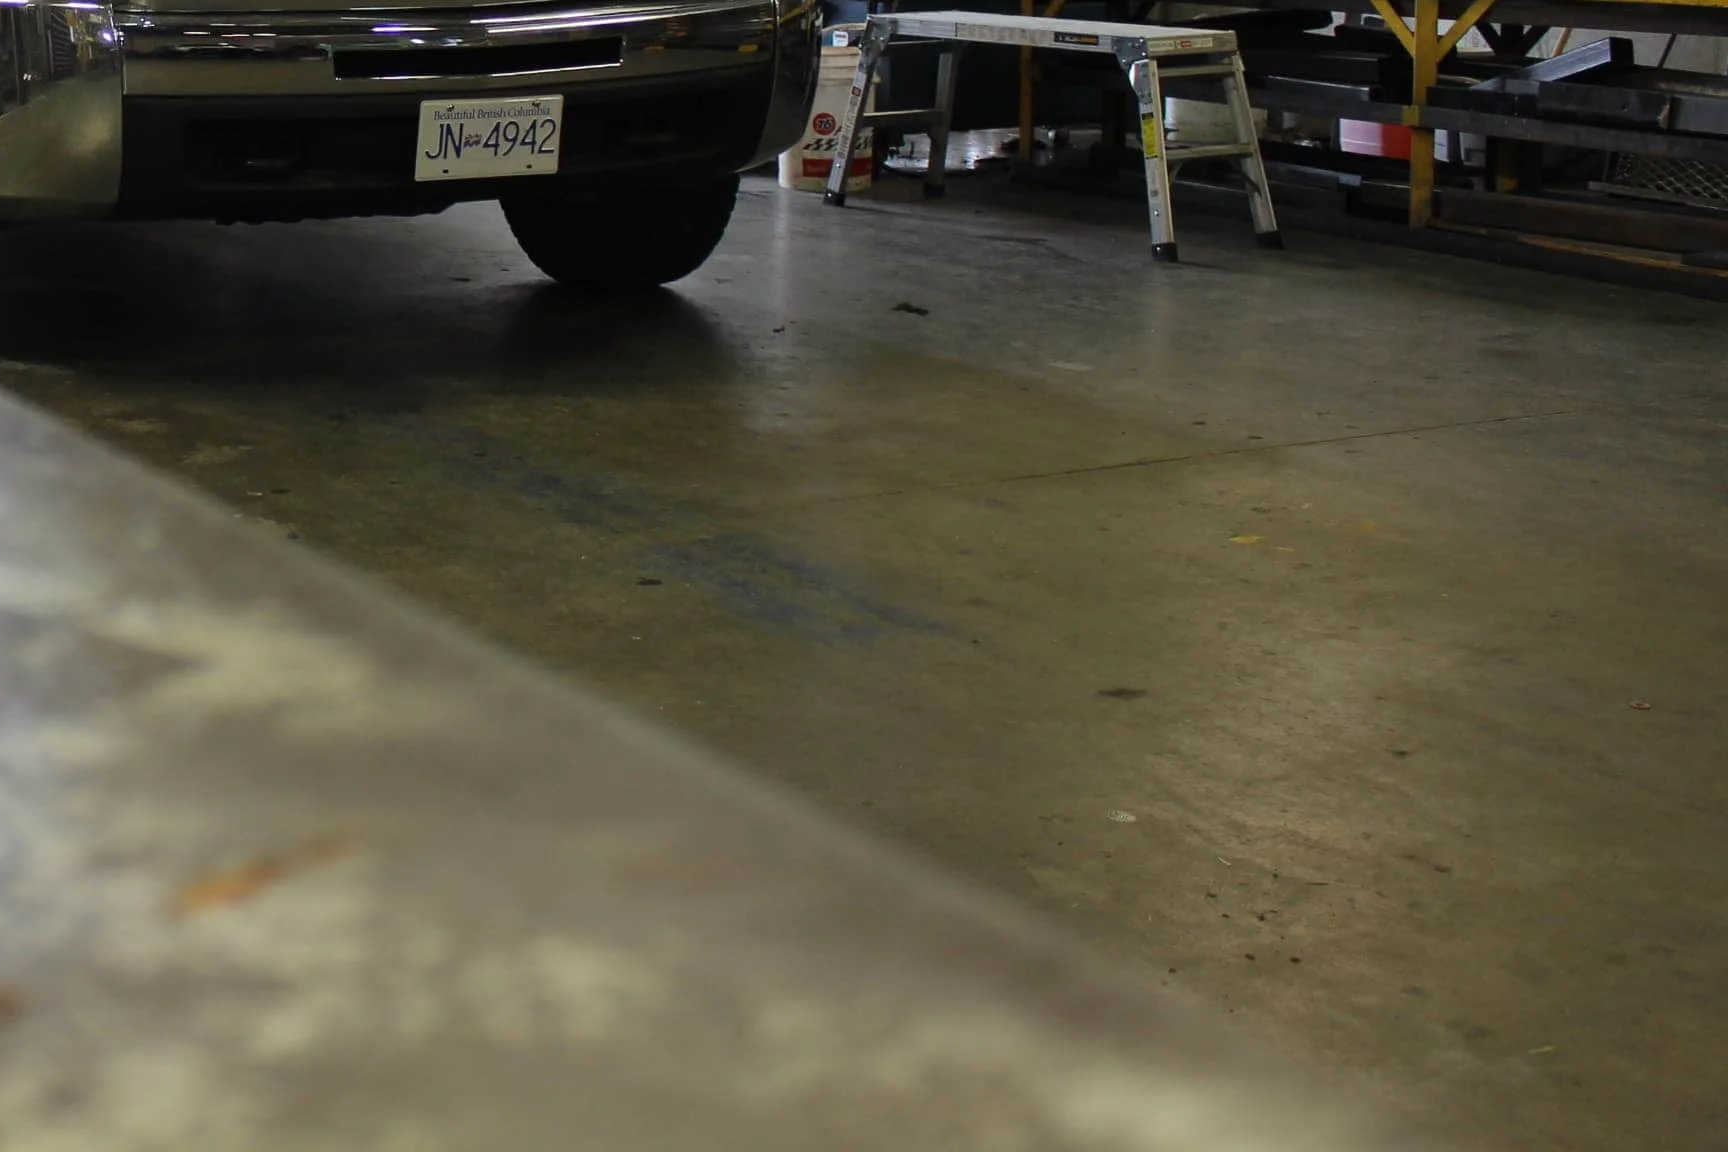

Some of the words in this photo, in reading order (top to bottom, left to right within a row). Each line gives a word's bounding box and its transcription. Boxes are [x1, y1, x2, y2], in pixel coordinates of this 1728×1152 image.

[434, 109, 475, 121] Beautiful
[477, 108, 506, 120] British
[508, 106, 551, 118] Columbia
[425, 122, 464, 159] JN
[483, 118, 557, 157] 4942
